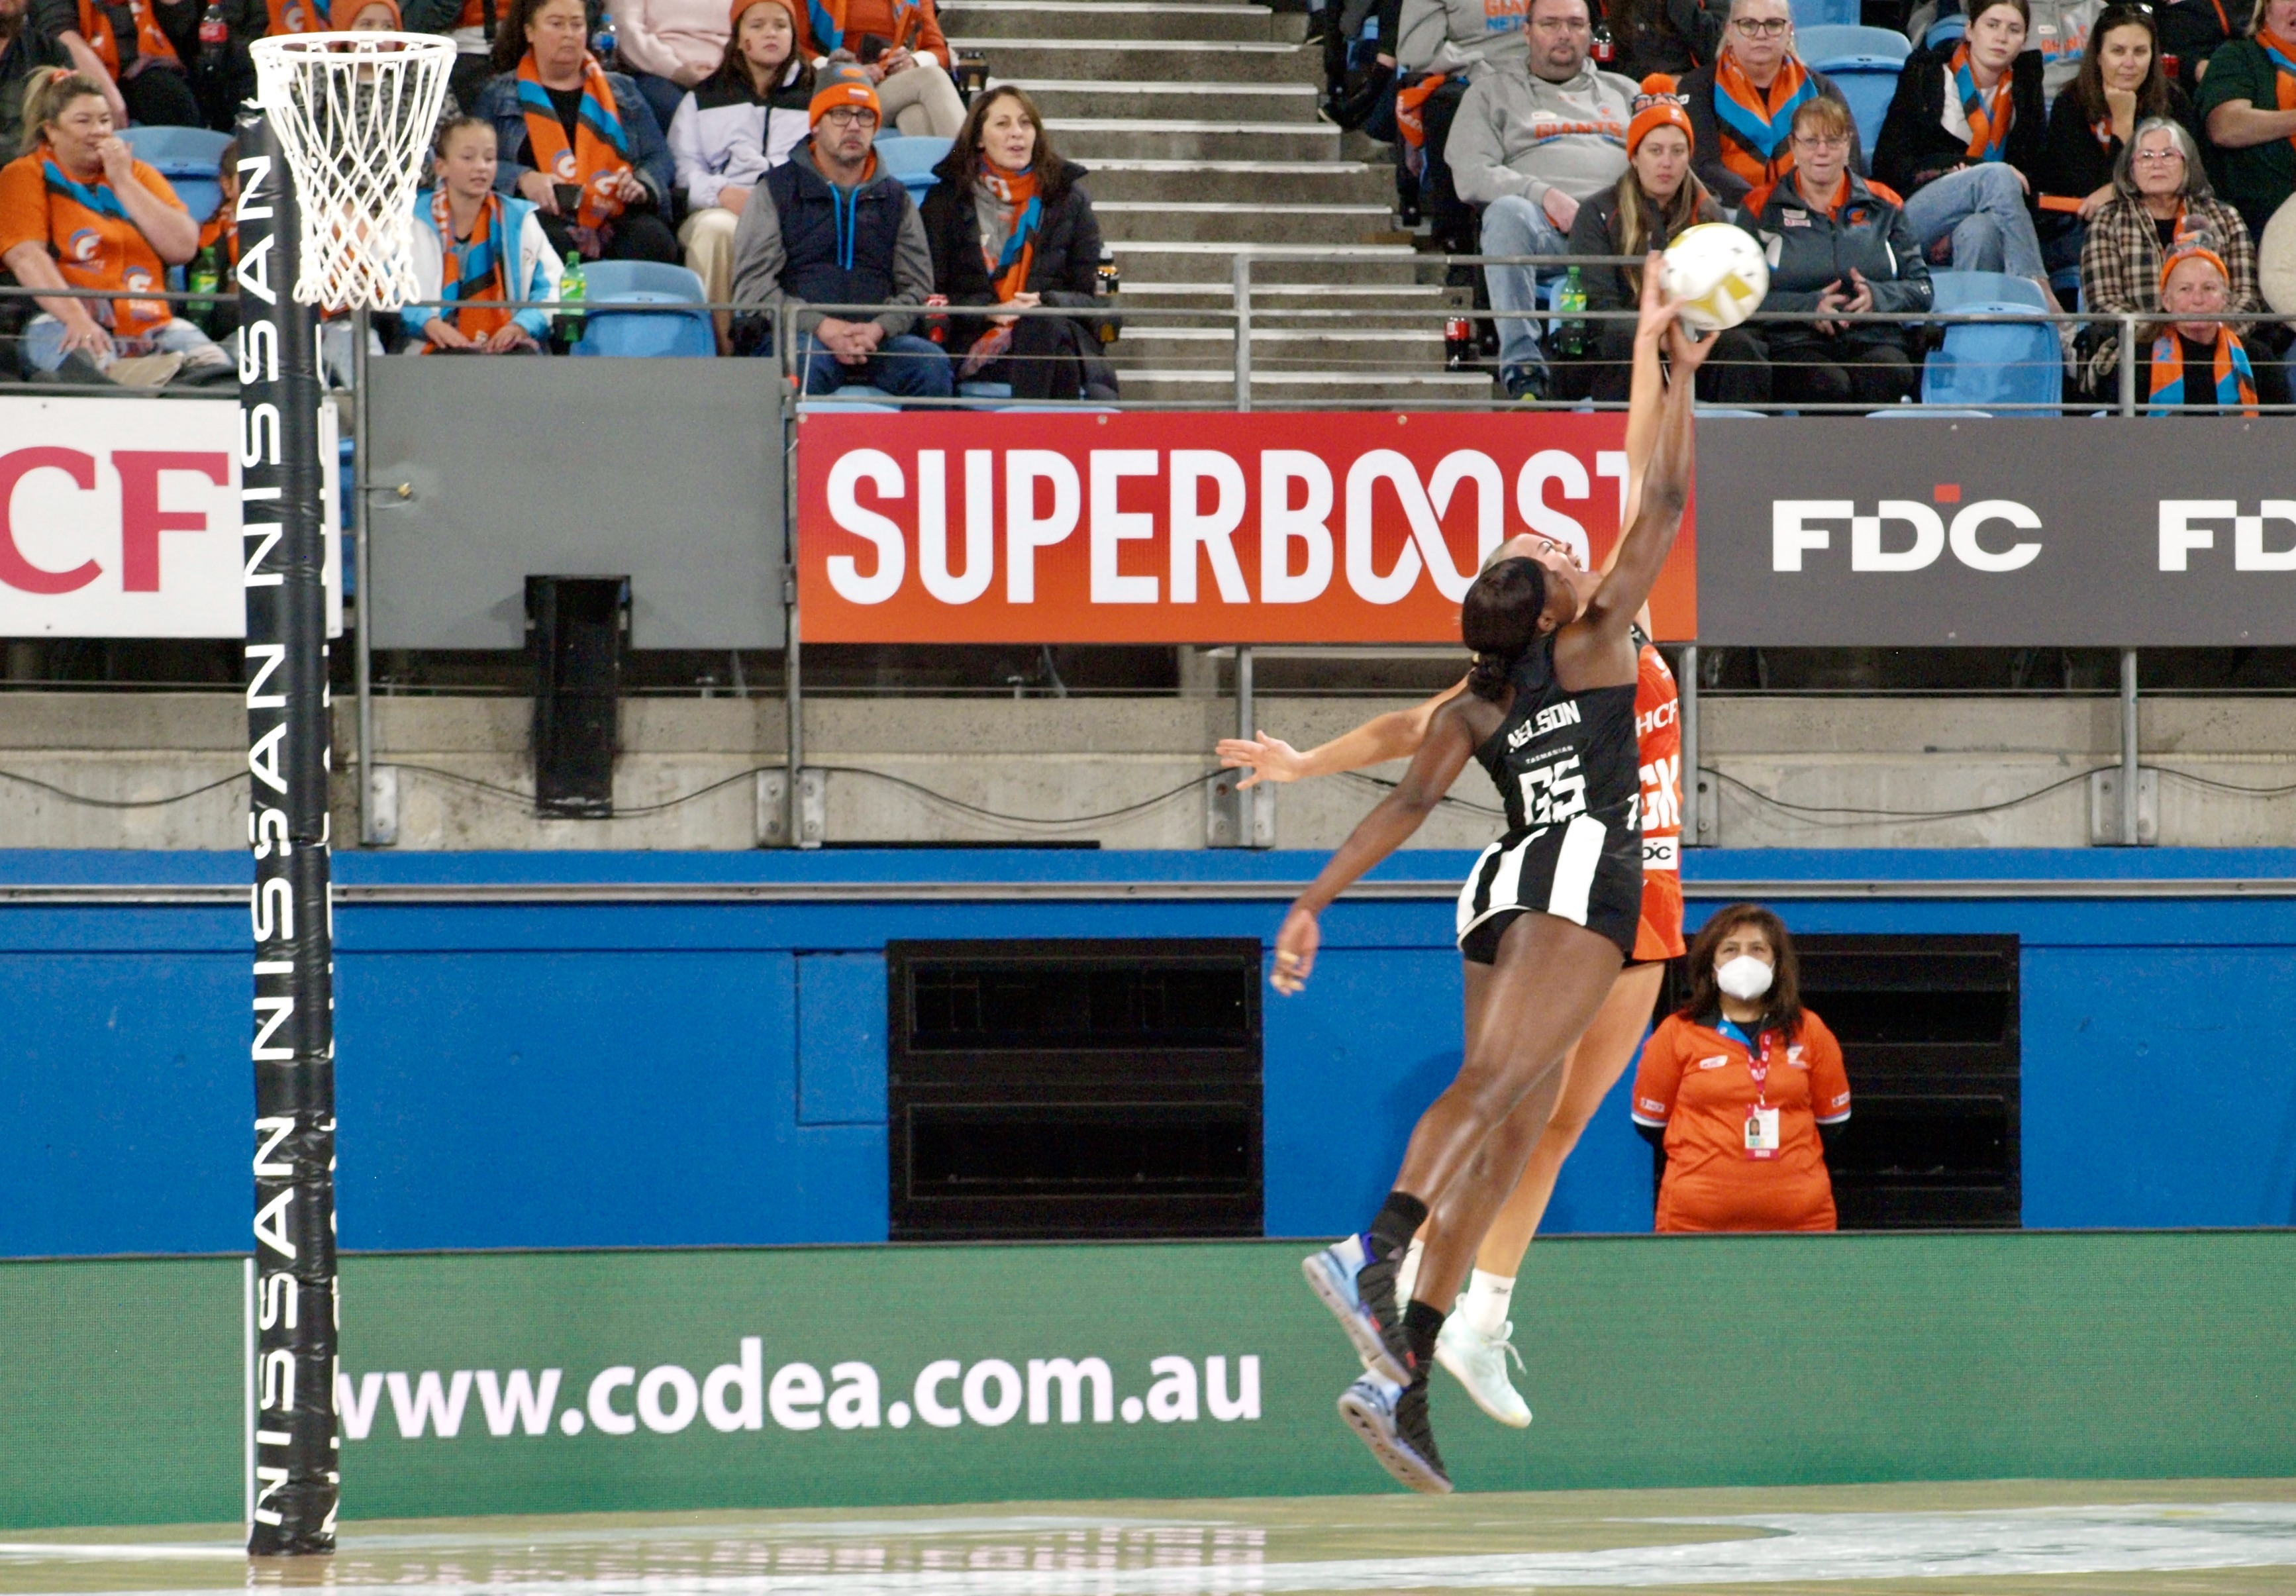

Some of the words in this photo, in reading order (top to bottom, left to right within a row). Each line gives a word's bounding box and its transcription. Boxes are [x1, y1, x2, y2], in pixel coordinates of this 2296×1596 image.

[236, 155, 283, 588] NISSAN
[0, 446, 229, 595] CF
[1773, 499, 2043, 572] FDC
[2158, 499, 2296, 572] FD
[1635, 697, 1679, 738] HCF
[245, 643, 295, 1061] NISSAN
[253, 1117, 299, 1526] NISSAN
